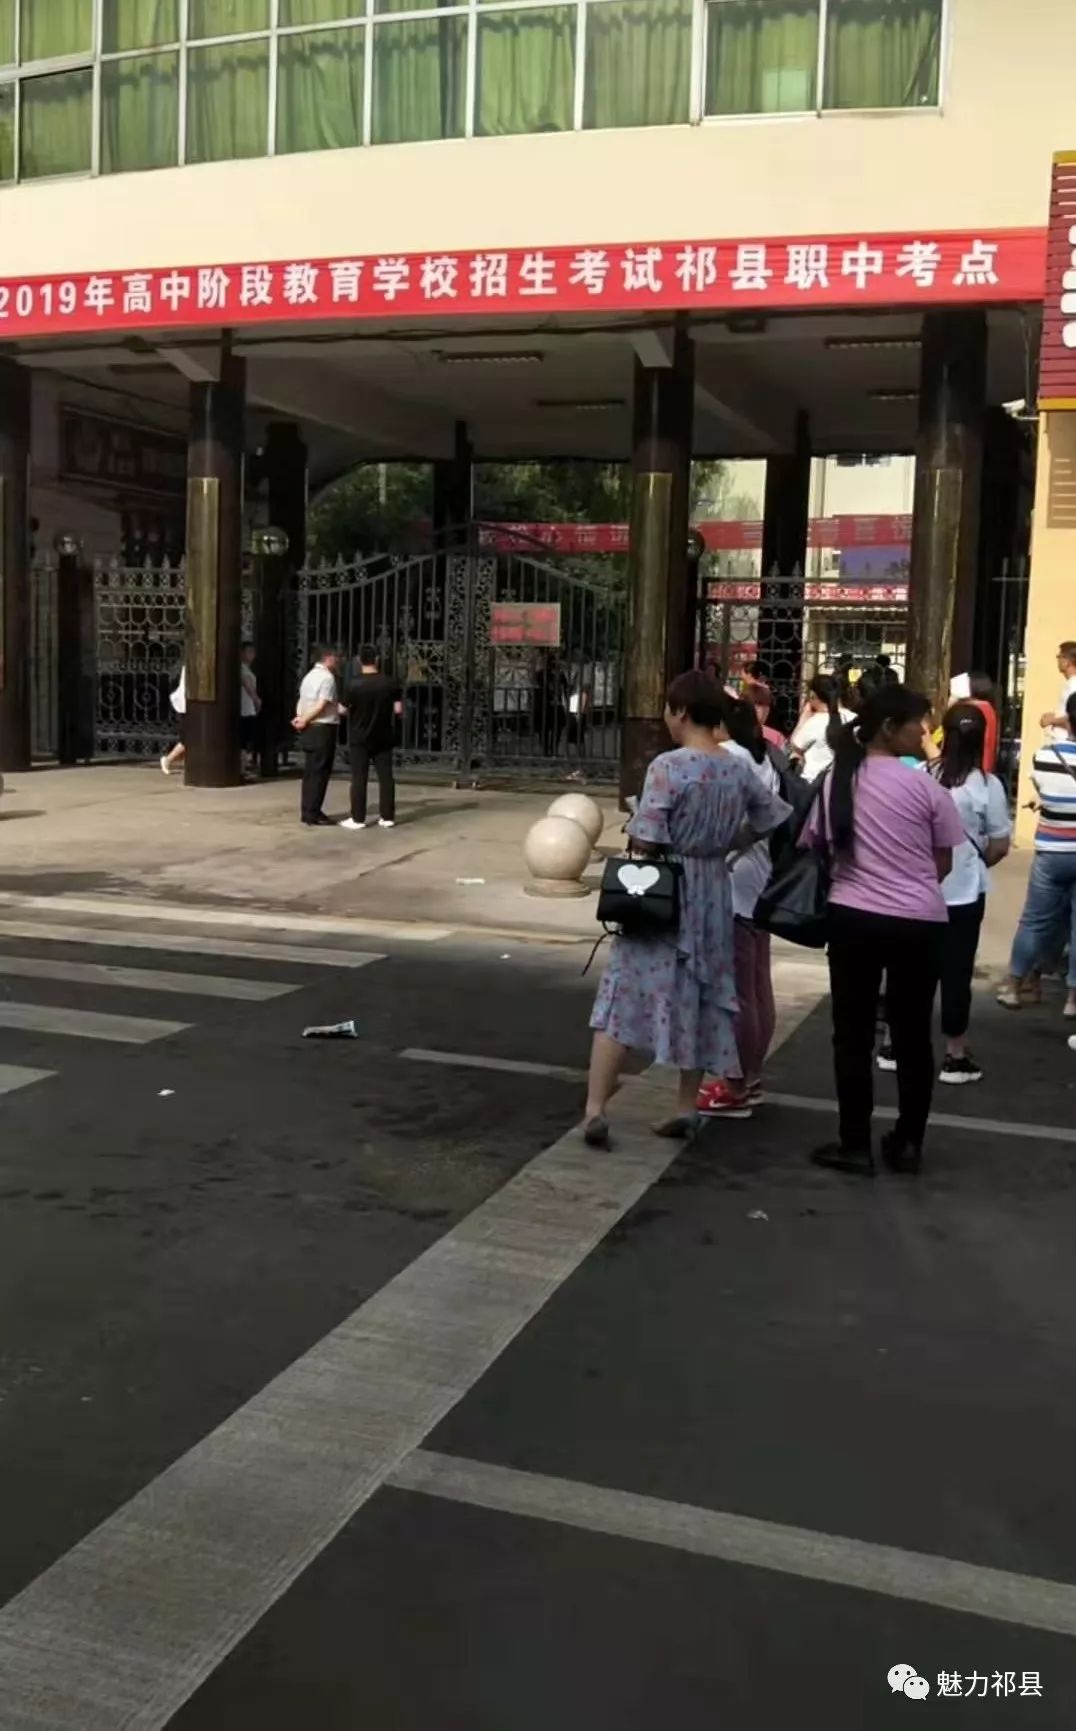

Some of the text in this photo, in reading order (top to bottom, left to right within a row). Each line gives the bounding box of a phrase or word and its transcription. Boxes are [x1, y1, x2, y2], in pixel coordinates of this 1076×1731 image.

[0, 239, 1000, 318] 2019年高中阶段教育学校招生考试祁县职中考点
